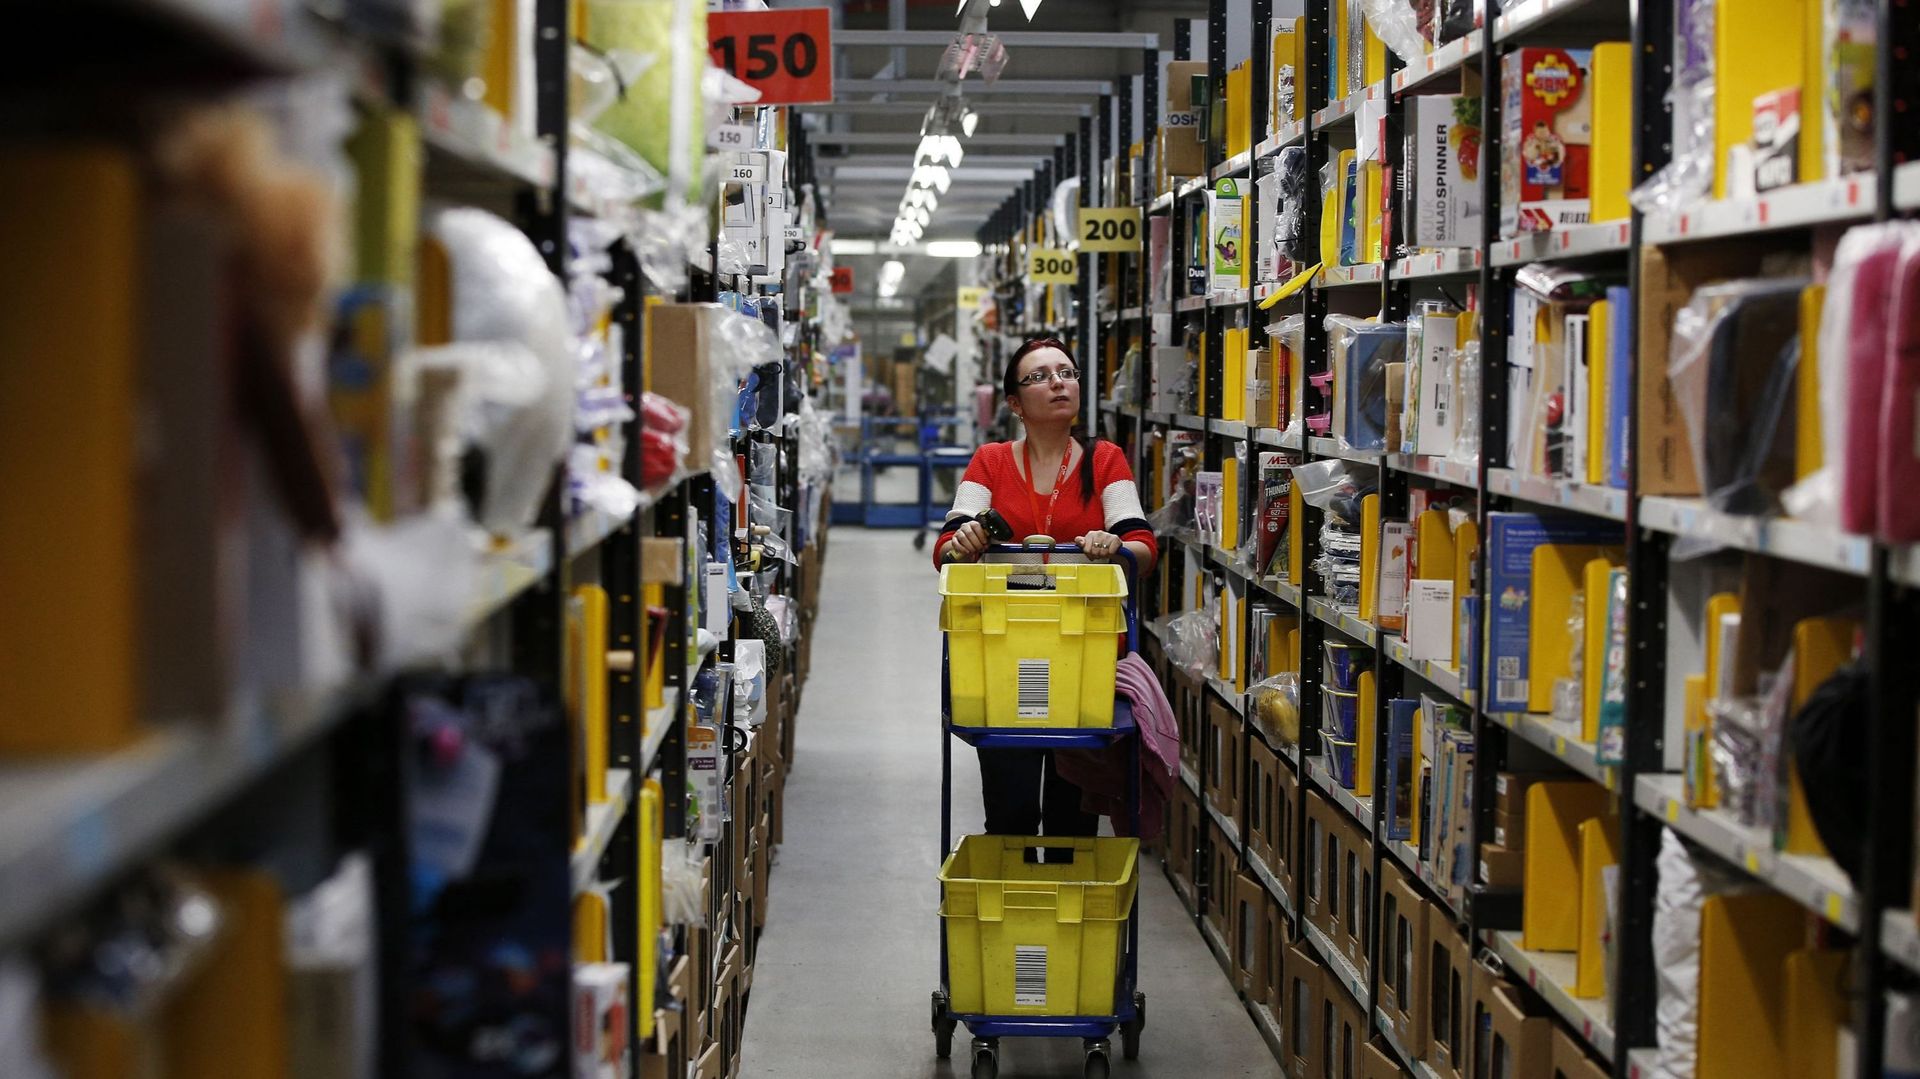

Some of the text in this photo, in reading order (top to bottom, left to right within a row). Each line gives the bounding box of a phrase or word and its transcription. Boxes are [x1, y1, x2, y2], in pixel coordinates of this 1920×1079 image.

[713, 33, 818, 80] 150
[1167, 113, 1199, 126] OSH
[719, 131, 741, 144] 150
[733, 169, 752, 178] 160
[1436, 124, 1447, 241] SALAD SPINNER
[1084, 219, 1136, 241] 200
[1034, 258, 1073, 275] 300
